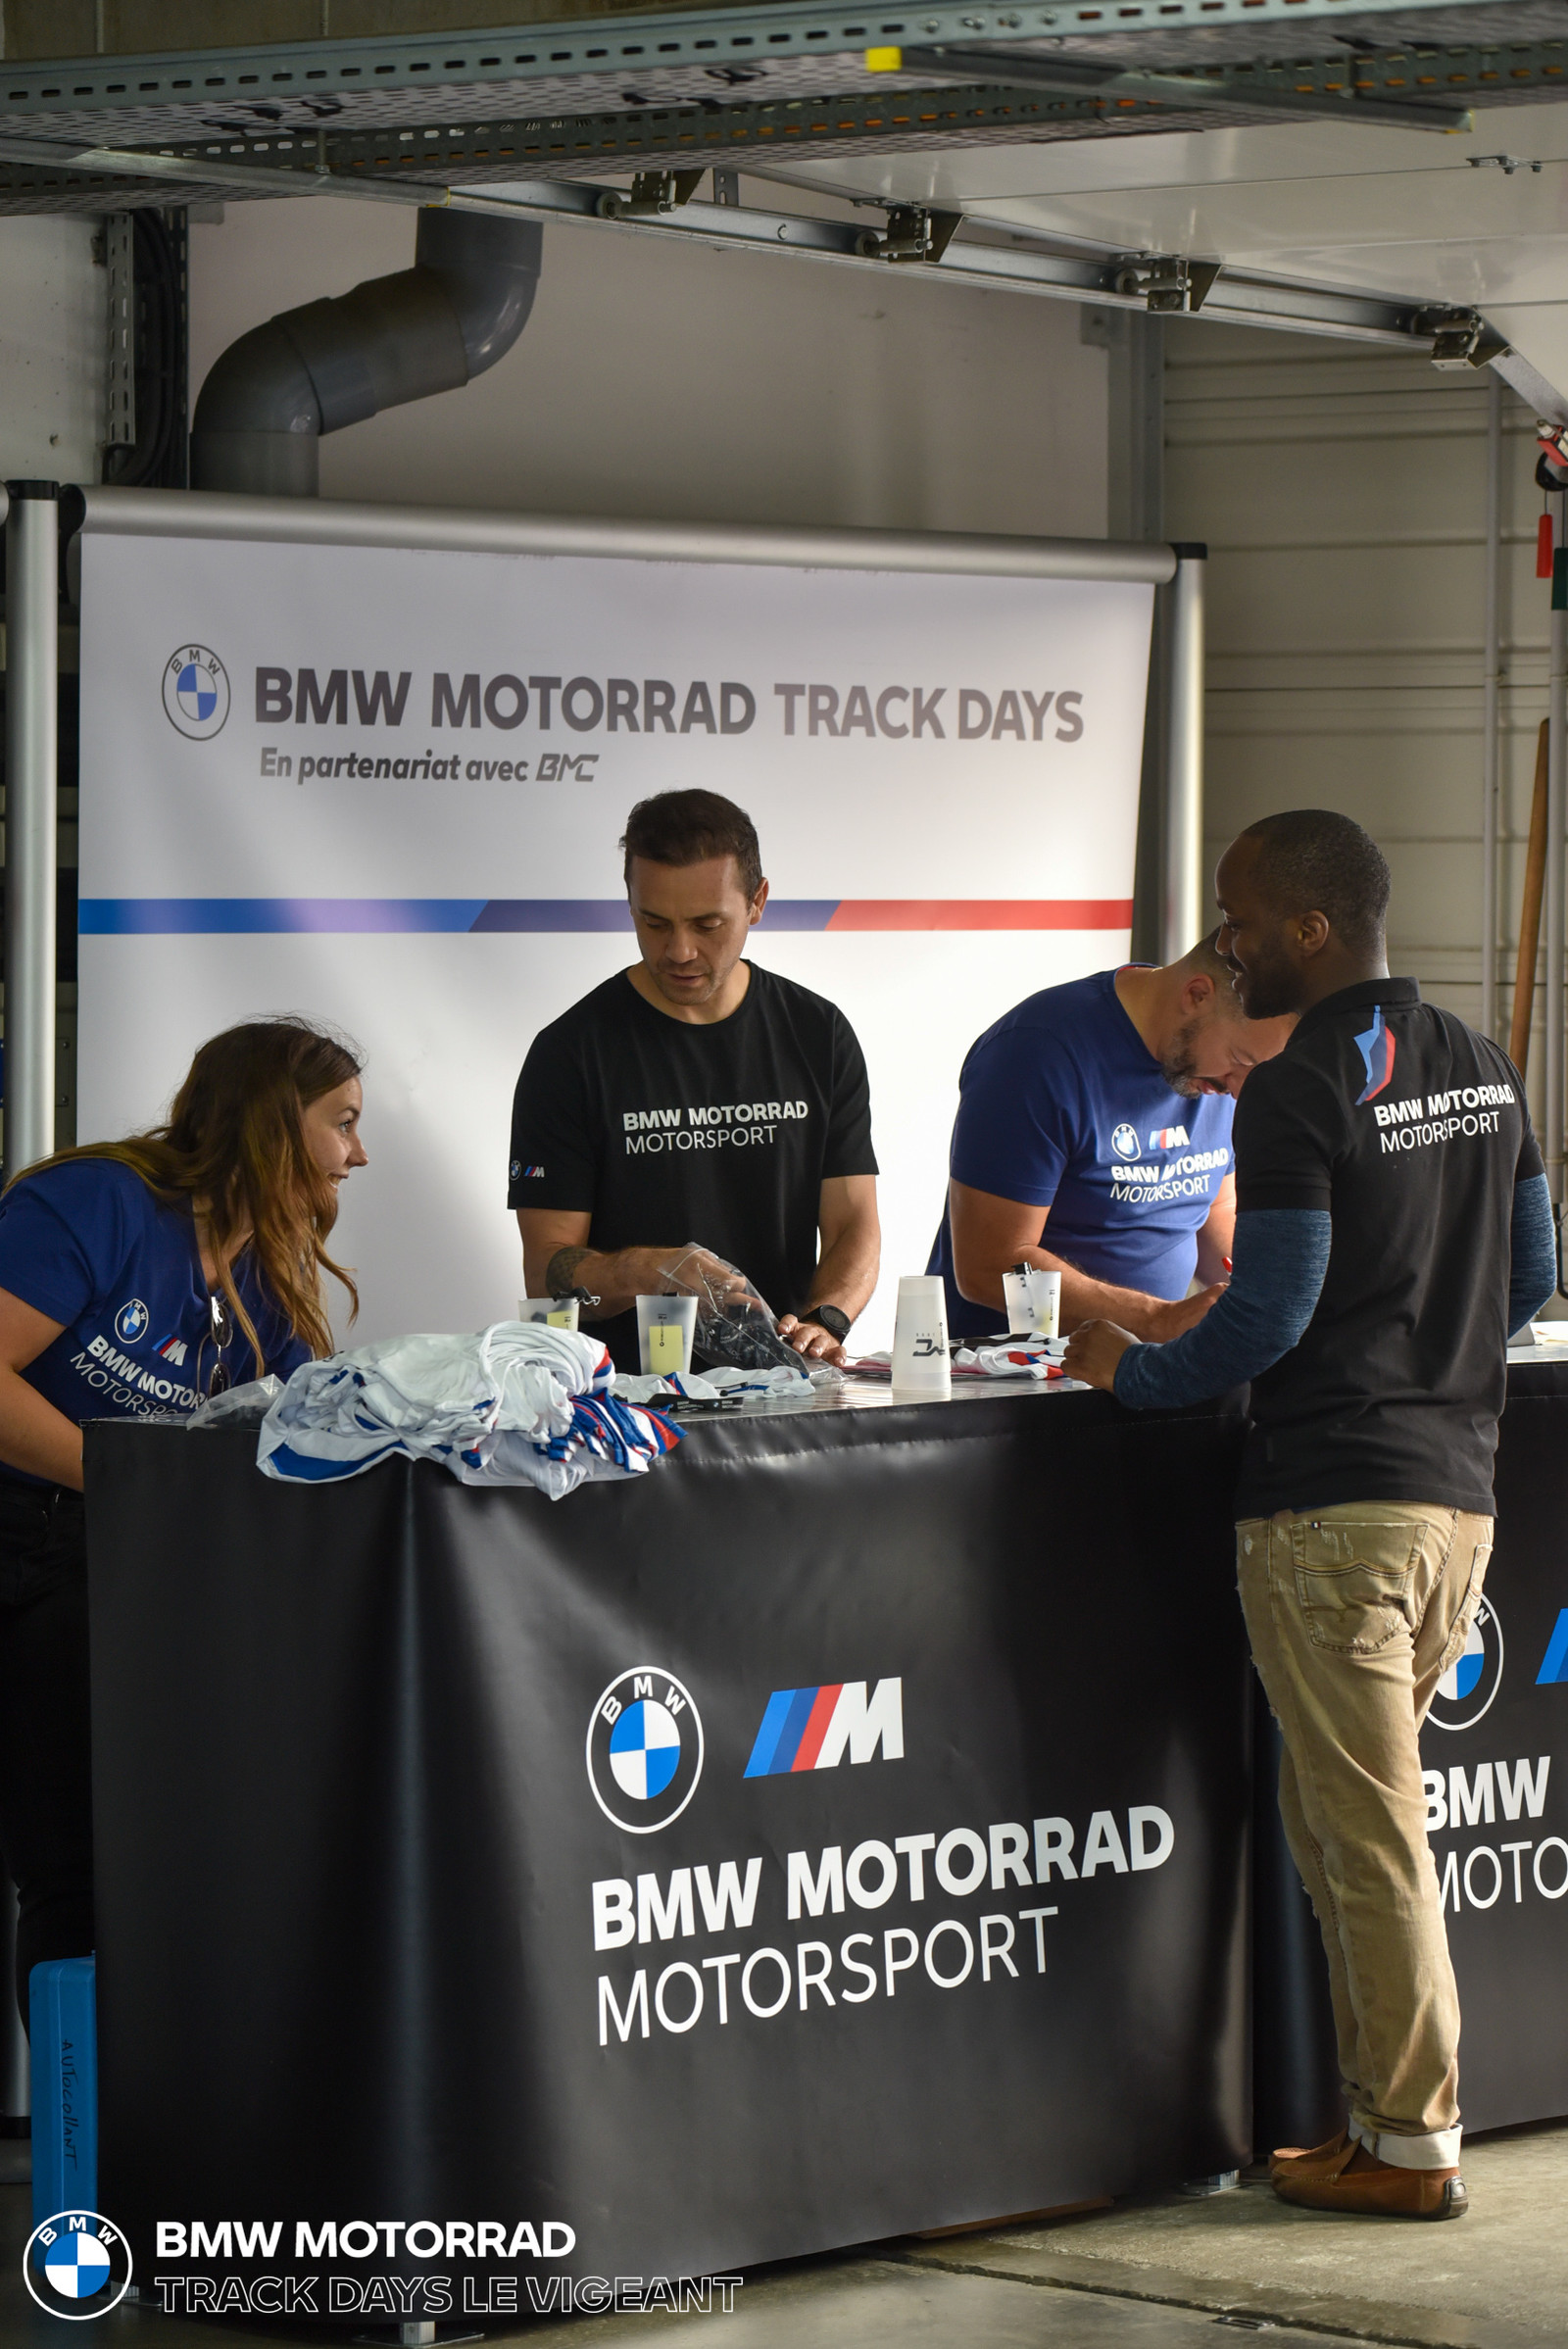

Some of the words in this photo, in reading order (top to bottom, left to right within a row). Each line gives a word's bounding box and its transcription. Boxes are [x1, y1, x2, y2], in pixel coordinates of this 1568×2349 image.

[171, 648, 221, 676] BMW
[255, 666, 413, 727] BMW
[431, 671, 757, 735] MOTORRAD
[773, 682, 948, 740] TRACK
[957, 688, 1085, 743] DAYS
[260, 747, 293, 777] En
[297, 749, 462, 785] partenariat
[466, 759, 529, 782] avec
[535, 753, 600, 782] BMC
[622, 1108, 682, 1132] BMW
[688, 1101, 809, 1126] MOTORRAD
[1374, 1098, 1424, 1127] BMW
[1428, 1084, 1515, 1117] MOTORRAD
[625, 1125, 778, 1155] MOTORSPORT
[1379, 1110, 1500, 1154] MOTORSPORT
[1109, 1174, 1211, 1203] MOTORSPORT
[1110, 1165, 1160, 1184] BMW
[86, 1335, 143, 1383] BMW
[600, 1675, 686, 1726] BMW
[814, 1677, 905, 1770] M
[1423, 1755, 1551, 1832] BMW
[591, 1856, 763, 1951] BMW
[786, 1805, 1176, 1921] MOTORRAD
[597, 1906, 1059, 2046] MOTORSPORT
